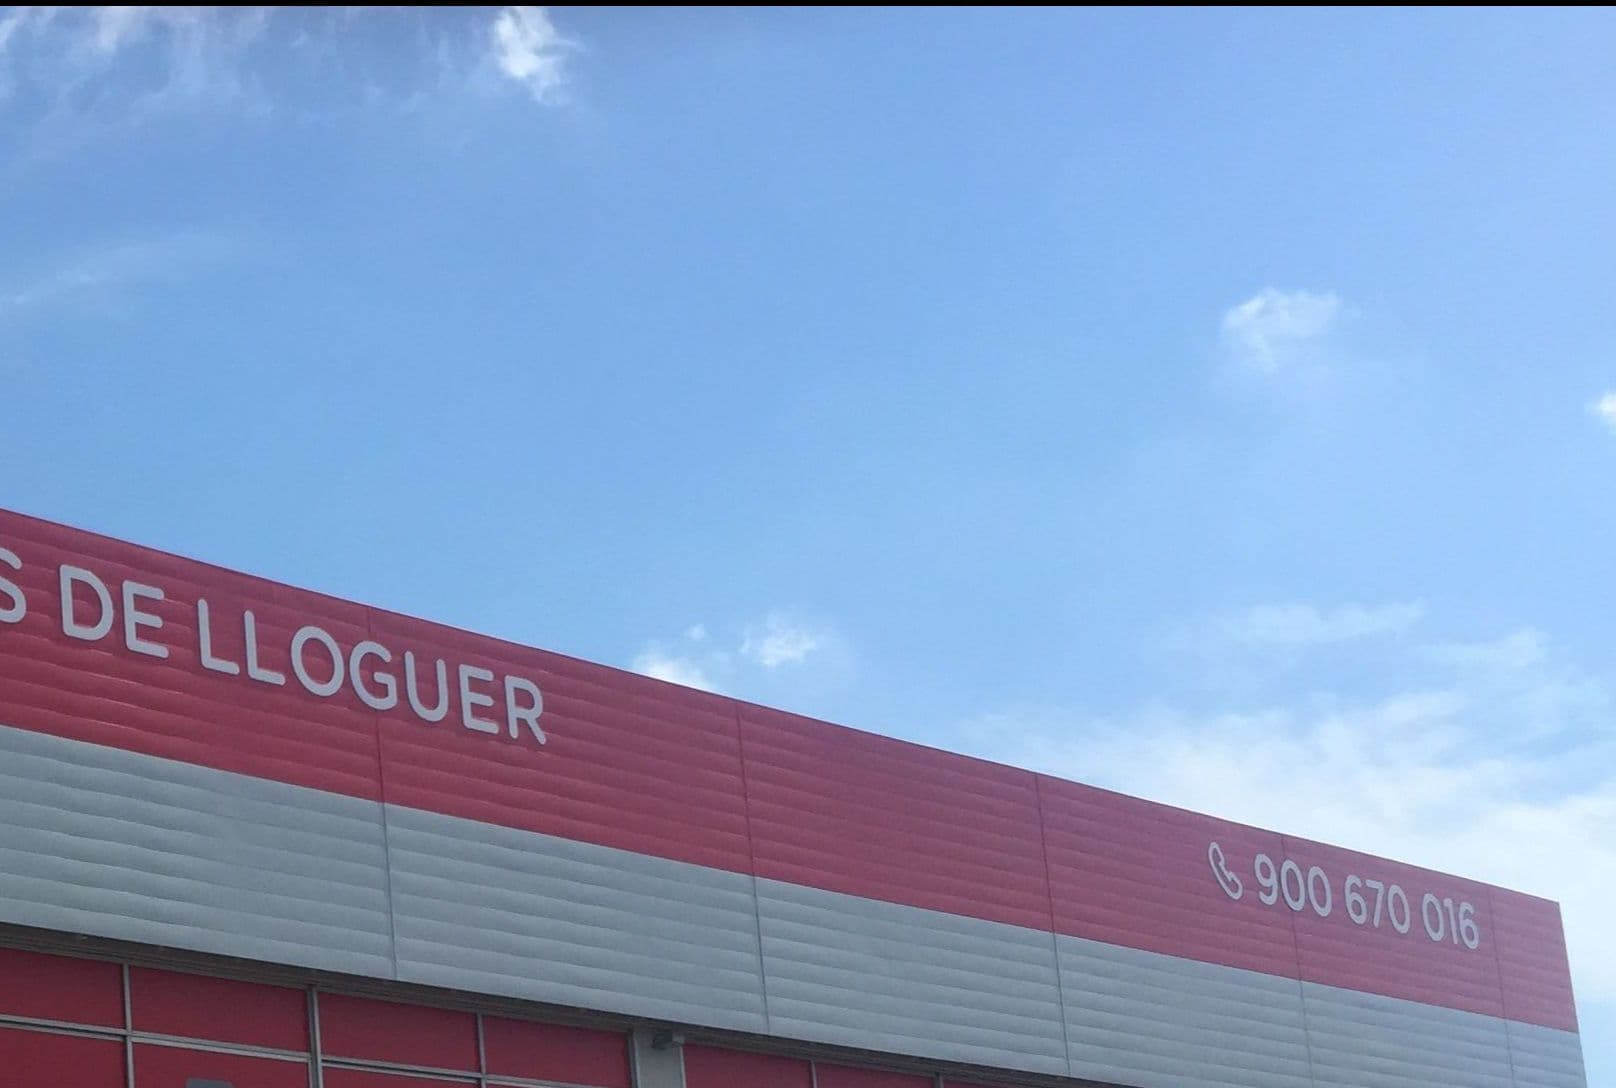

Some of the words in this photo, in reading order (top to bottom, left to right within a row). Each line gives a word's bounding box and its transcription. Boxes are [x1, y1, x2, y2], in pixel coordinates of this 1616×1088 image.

[59, 563, 170, 659] DE
[197, 597, 550, 746] LLOGUER
[1253, 852, 1333, 918] 900
[1344, 873, 1411, 935] 670
[1421, 892, 1480, 950] 016
